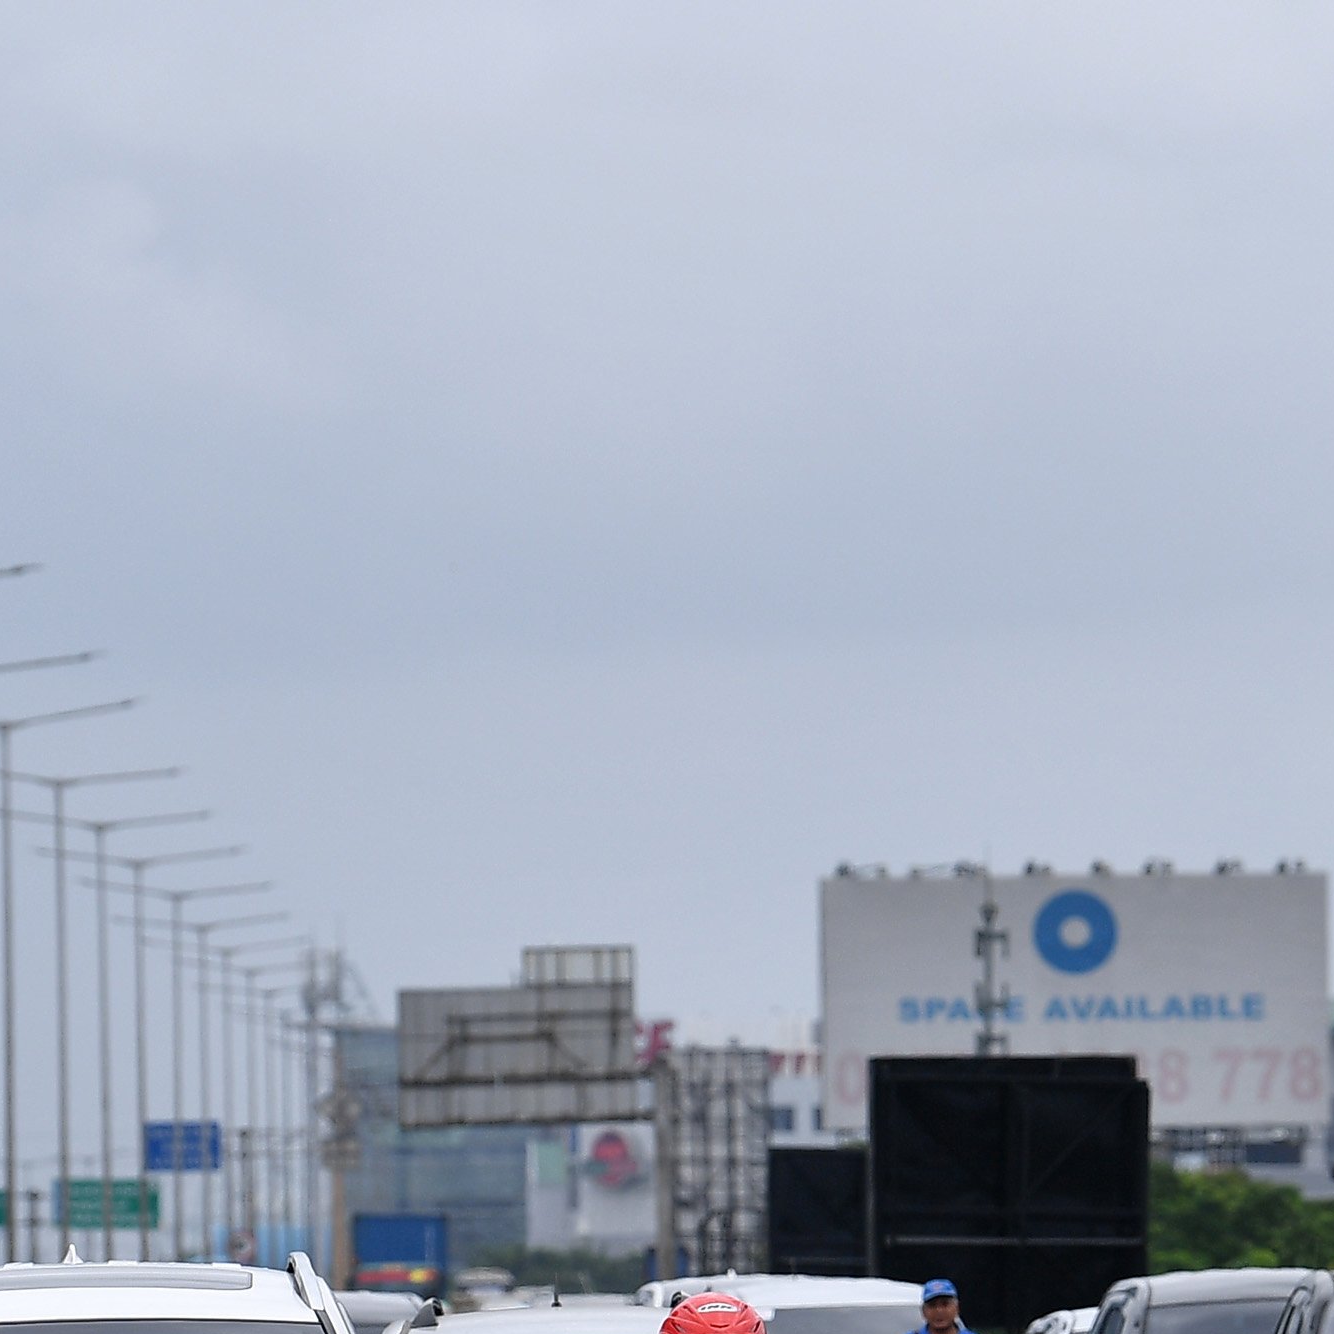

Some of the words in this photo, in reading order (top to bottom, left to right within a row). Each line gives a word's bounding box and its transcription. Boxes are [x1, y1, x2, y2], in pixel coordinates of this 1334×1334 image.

[899, 996, 1025, 1021] SPAE
[1043, 993, 1265, 1021] AVAILABLE
[1212, 1044, 1324, 1103] 778
